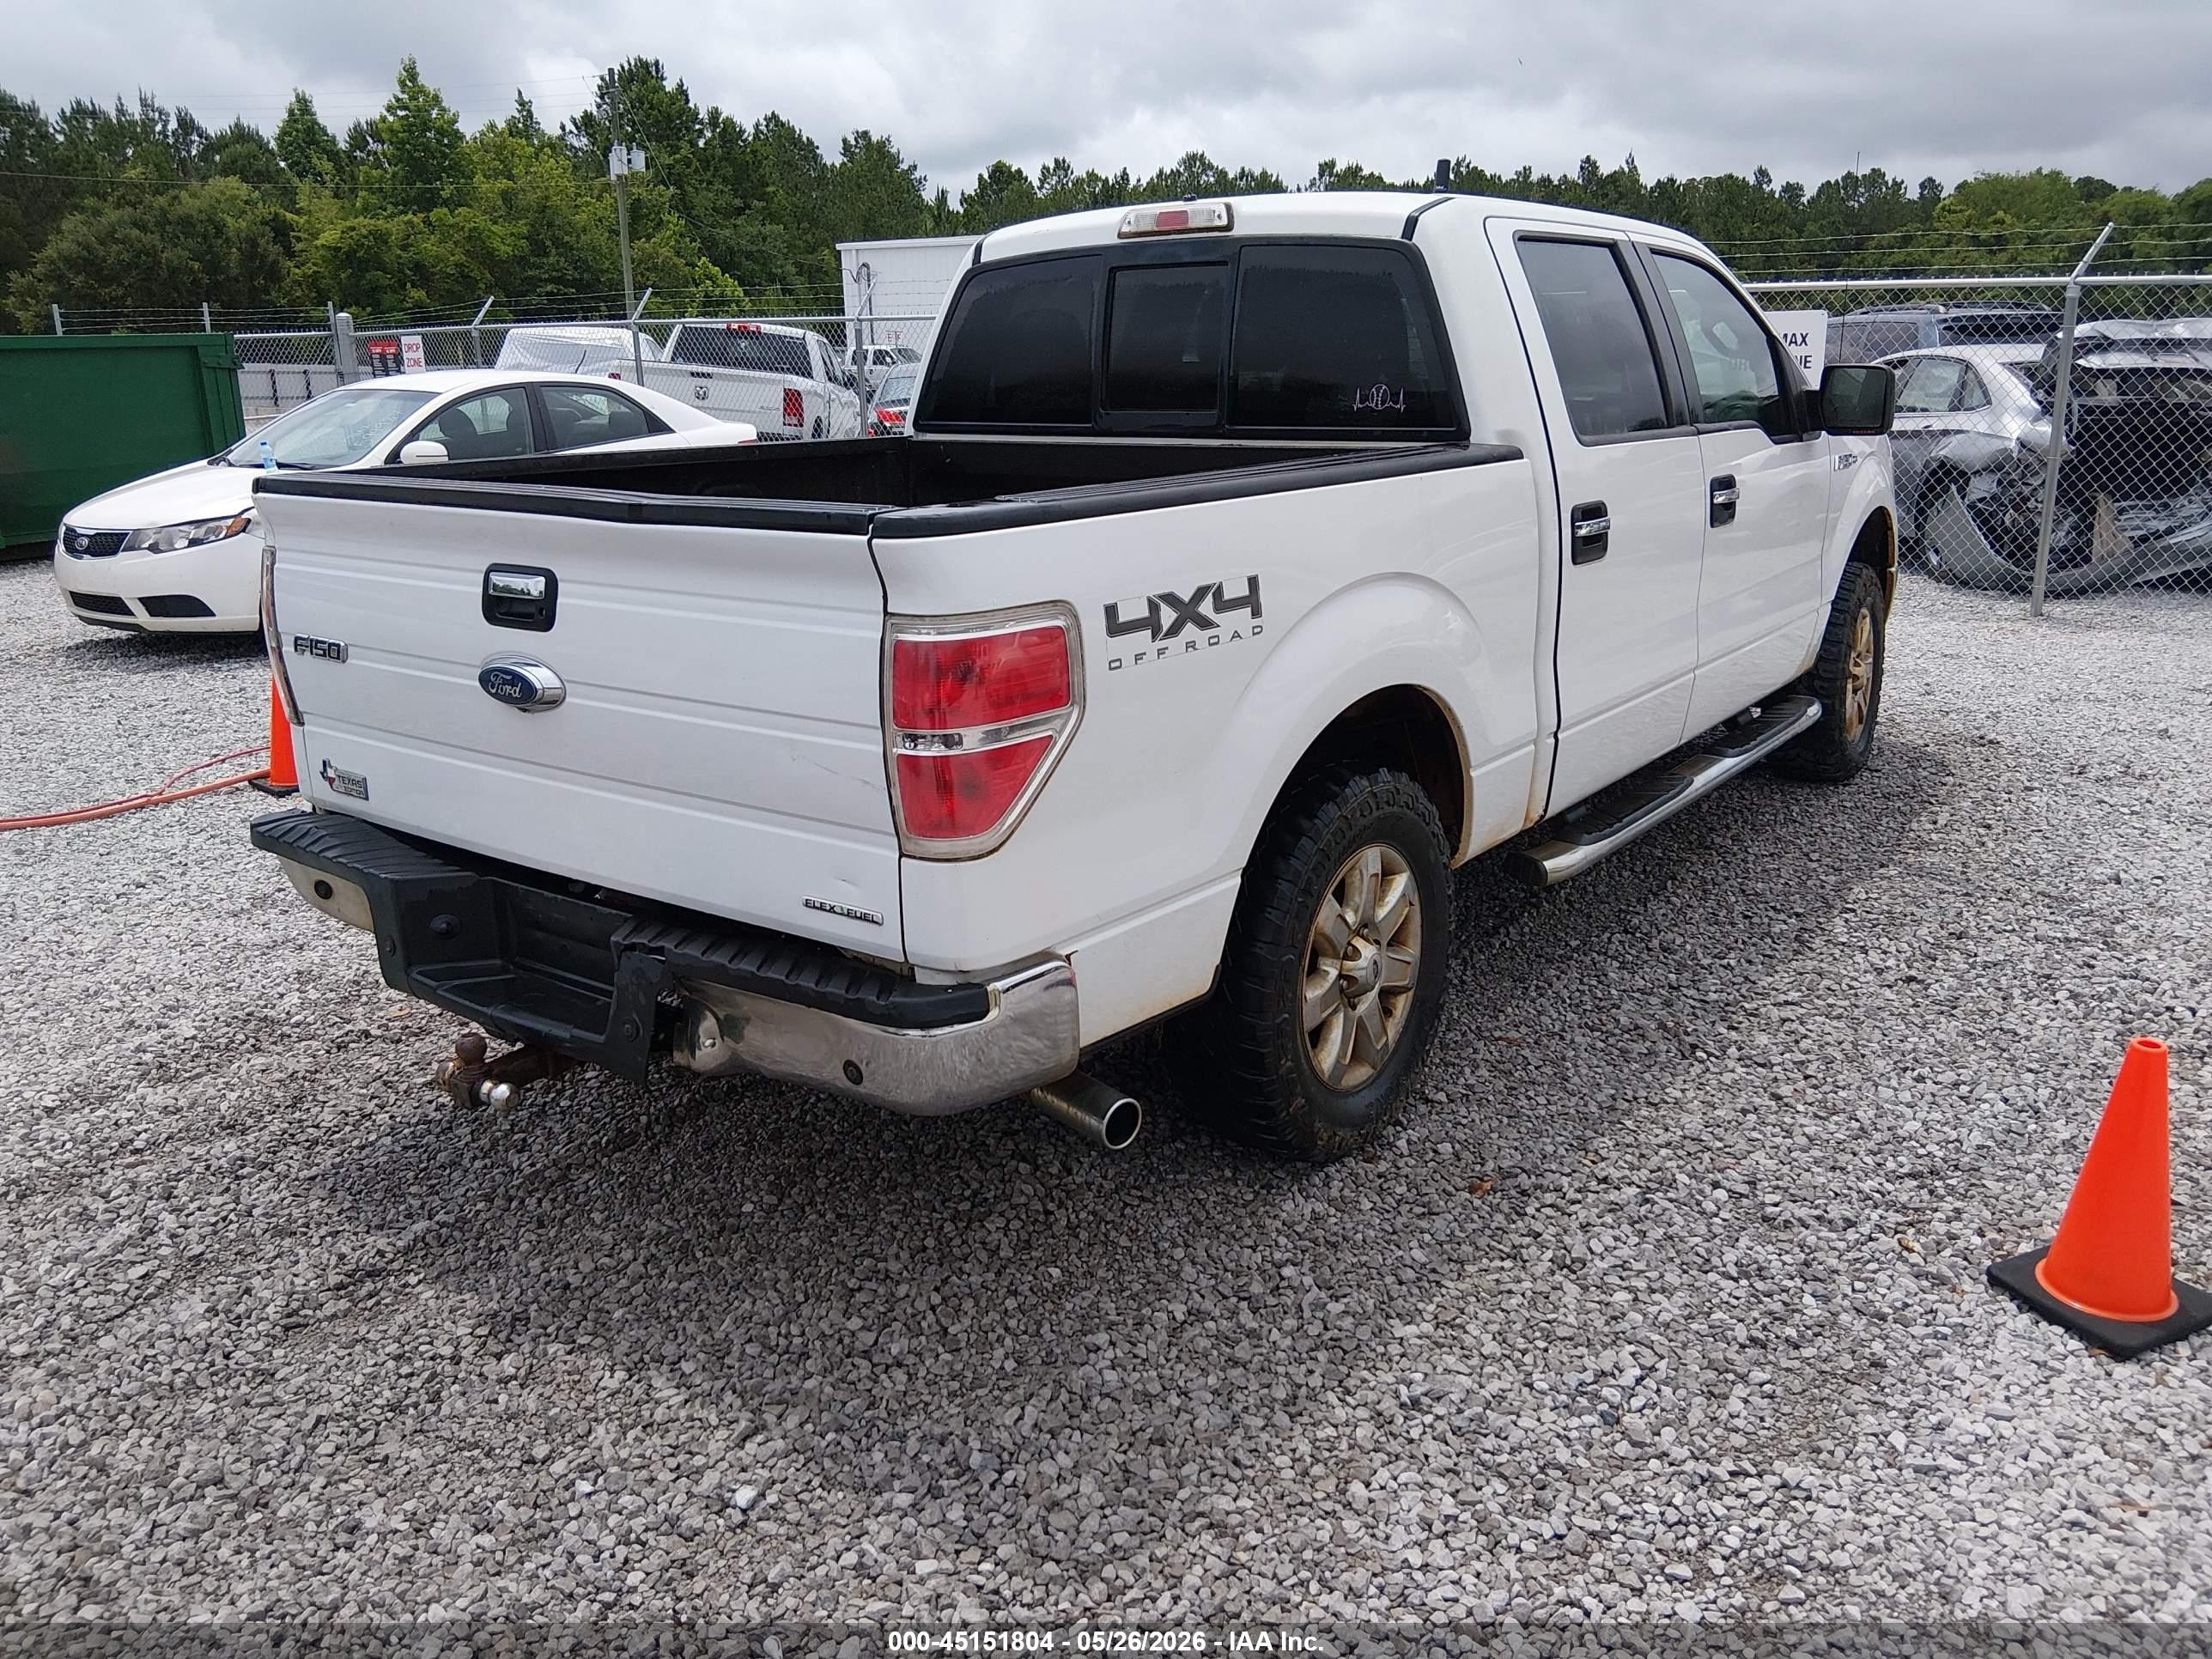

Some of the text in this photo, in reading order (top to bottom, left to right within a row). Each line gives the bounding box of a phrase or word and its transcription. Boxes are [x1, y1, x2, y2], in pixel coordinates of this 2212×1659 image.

[404, 343, 420, 353] DROP
[405, 357, 422, 368] ZONE
[488, 671, 522, 698] Ford
[337, 775, 362, 789] TEXAS
[846, 908, 880, 925] FUEL
